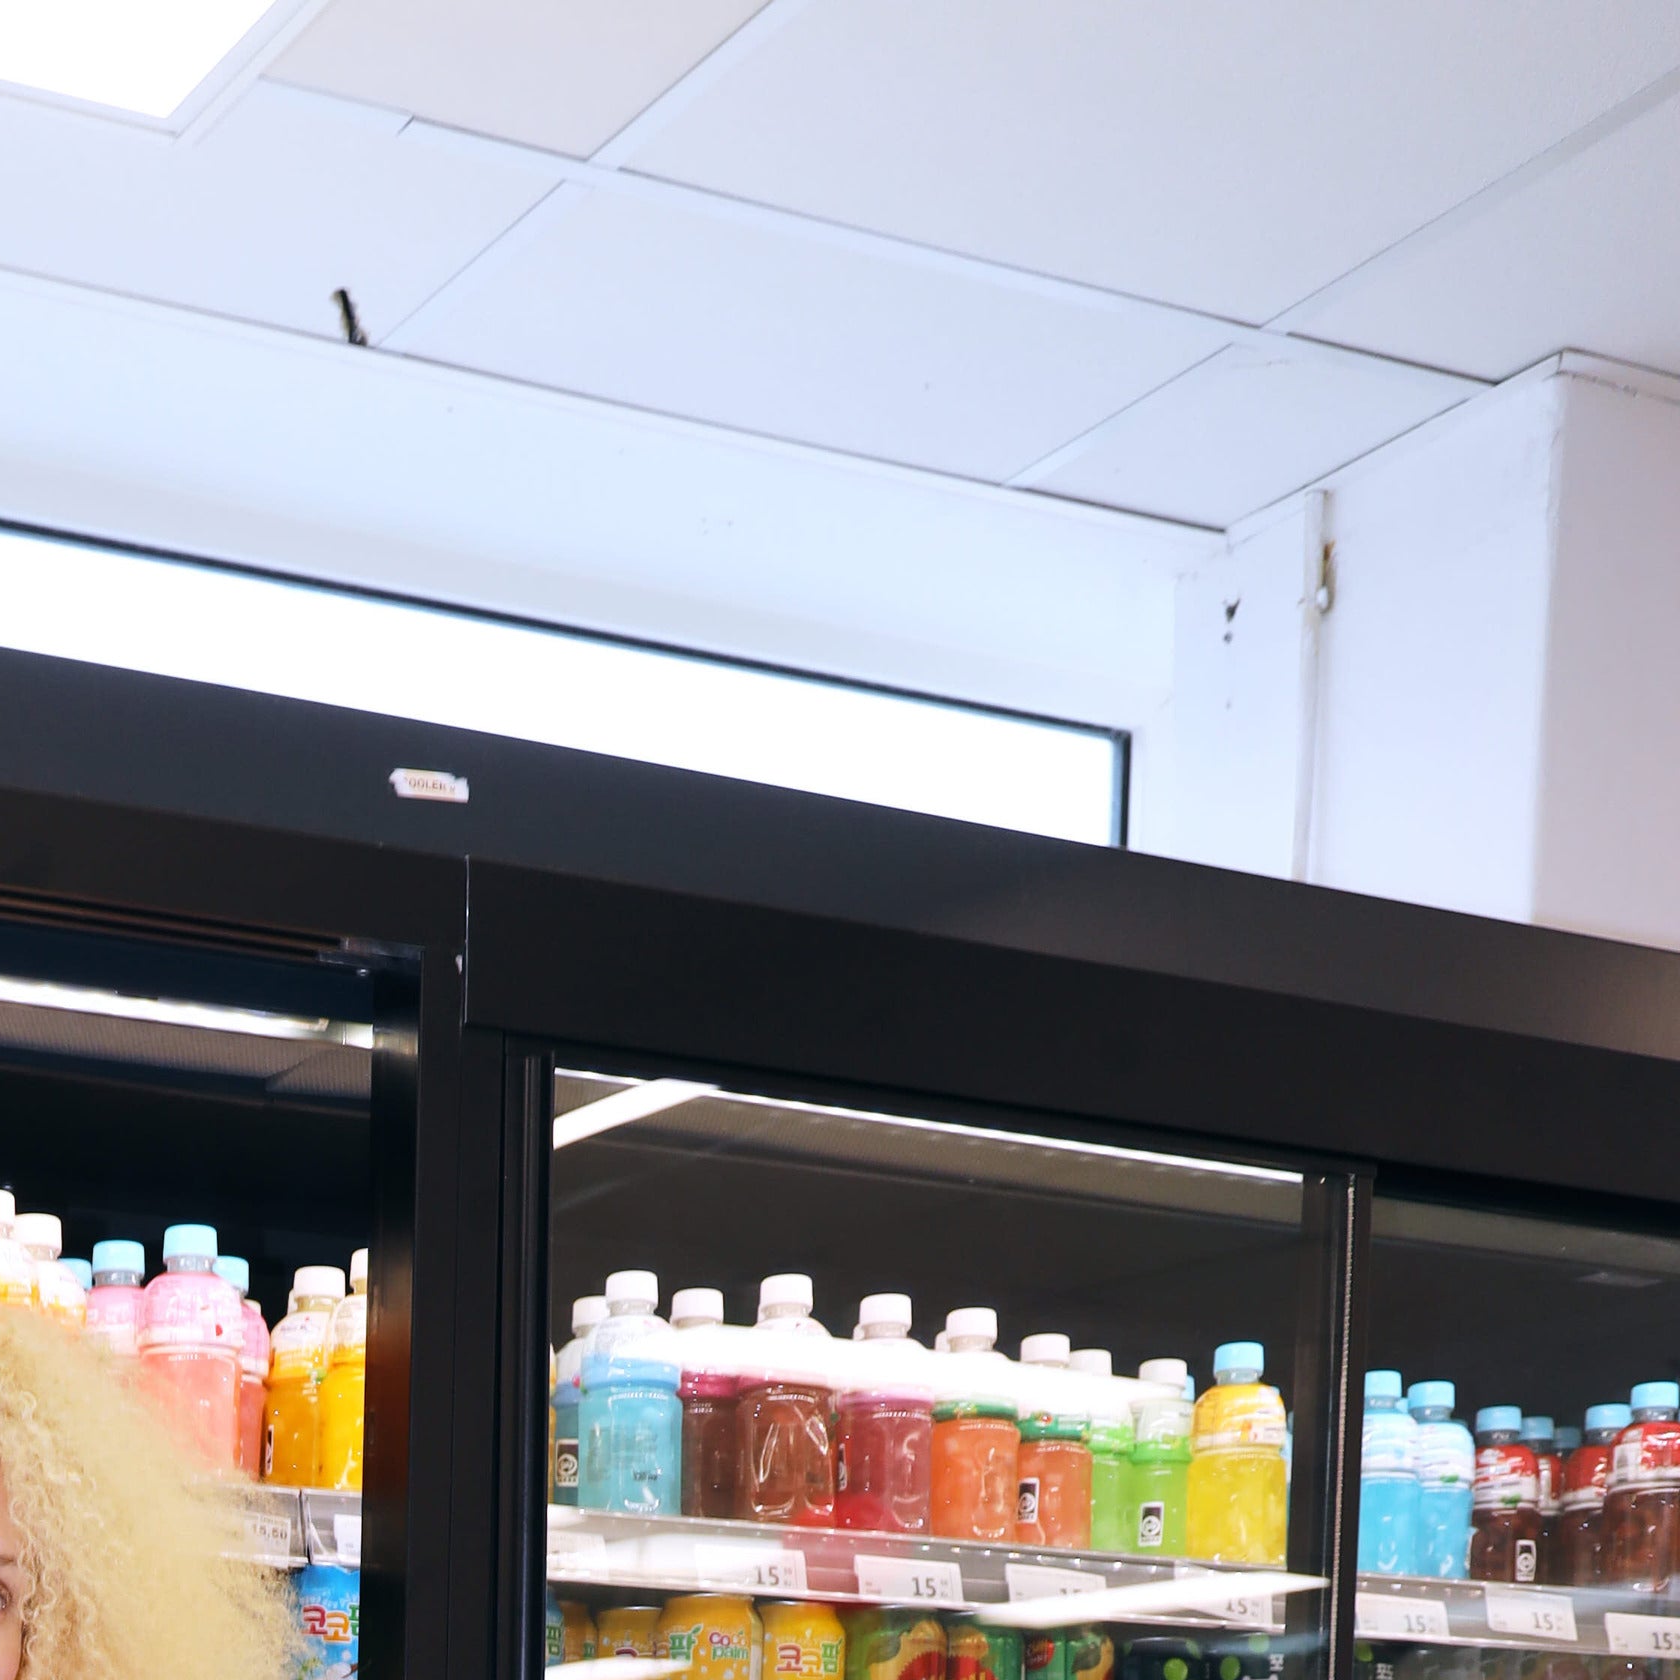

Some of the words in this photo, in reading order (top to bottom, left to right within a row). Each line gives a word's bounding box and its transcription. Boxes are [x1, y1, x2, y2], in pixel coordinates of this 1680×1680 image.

[755, 1566, 779, 1586] 15
[911, 1577, 936, 1597] 15
[1404, 1614, 1427, 1633] 15
[1533, 1612, 1554, 1631] 15
[1652, 1631, 1673, 1650] 15
[776, 1638, 843, 1678] 코코팜
